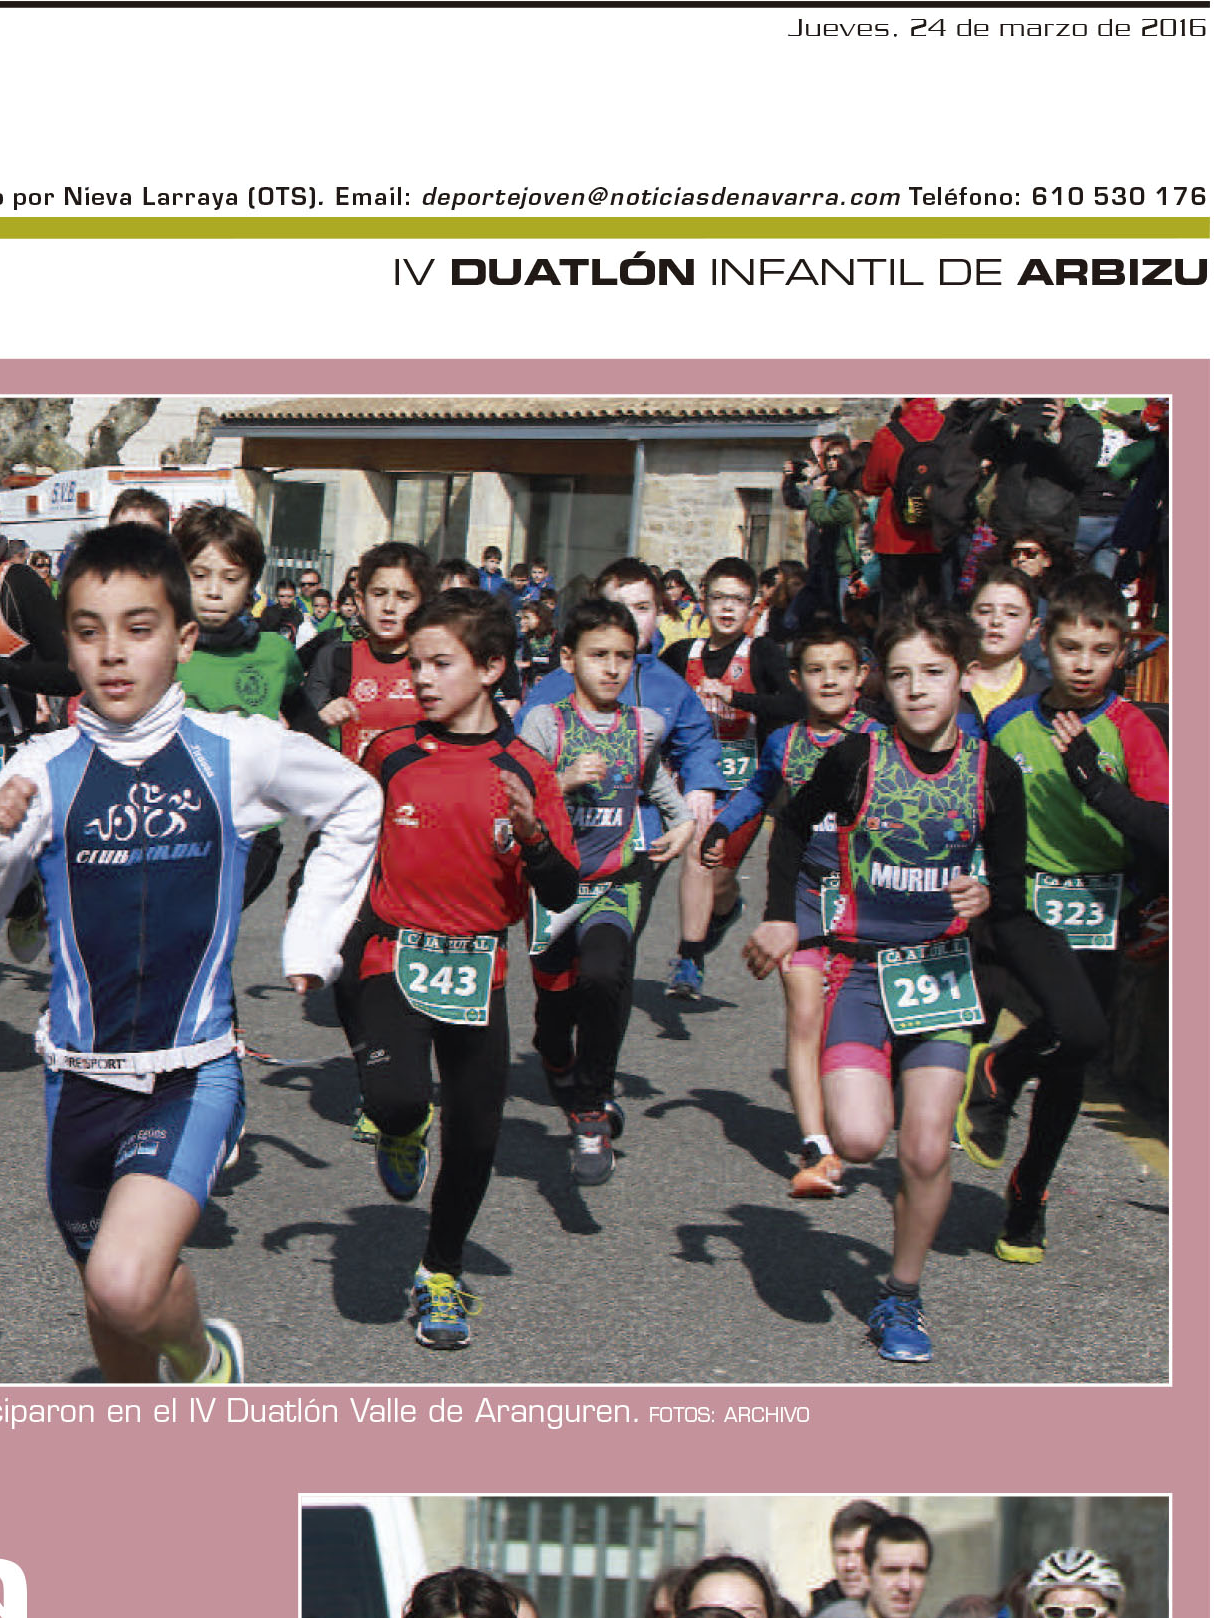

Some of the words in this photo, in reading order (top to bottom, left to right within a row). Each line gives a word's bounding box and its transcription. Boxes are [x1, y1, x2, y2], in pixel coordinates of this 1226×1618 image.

[910, 18, 947, 37] 24
[956, 18, 989, 37] de
[999, 23, 1088, 37] marzo
[1097, 18, 1131, 37] de
[1141, 18, 1207, 37] 2016
[13, 192, 55, 211] por
[64, 186, 132, 206] Nieva
[142, 186, 238, 211] Larraya
[248, 186, 324, 210] (OTS).
[335, 186, 410, 206] Email:
[422, 186, 901, 211] deportejoven@noticiasdenavarra.com
[908, 186, 1020, 206] Teléfono:
[1032, 186, 1084, 206] 610
[1094, 186, 1145, 206] 530
[1155, 186, 1206, 206] 176
[394, 258, 436, 286] IV
[451, 250, 695, 286] DUATLÓN
[711, 258, 925, 286] INFANTIL
[939, 258, 1003, 286] DE
[1016, 258, 1208, 286] ARBIZU
[716, 756, 751, 775] 37
[1045, 899, 1105, 927] 323
[408, 961, 478, 997] 243
[893, 971, 962, 1008] 291
[107, 1404, 141, 1423] en
[153, 1397, 177, 1423] el
[190, 1397, 217, 1423] IV
[227, 1397, 338, 1423] Duatlón
[349, 1397, 417, 1423] Valle
[428, 1397, 463, 1423] de
[474, 1397, 639, 1430] Aranguren.
[649, 1406, 715, 1423] FOTOS:
[723, 1406, 810, 1423] ARCHIVO
